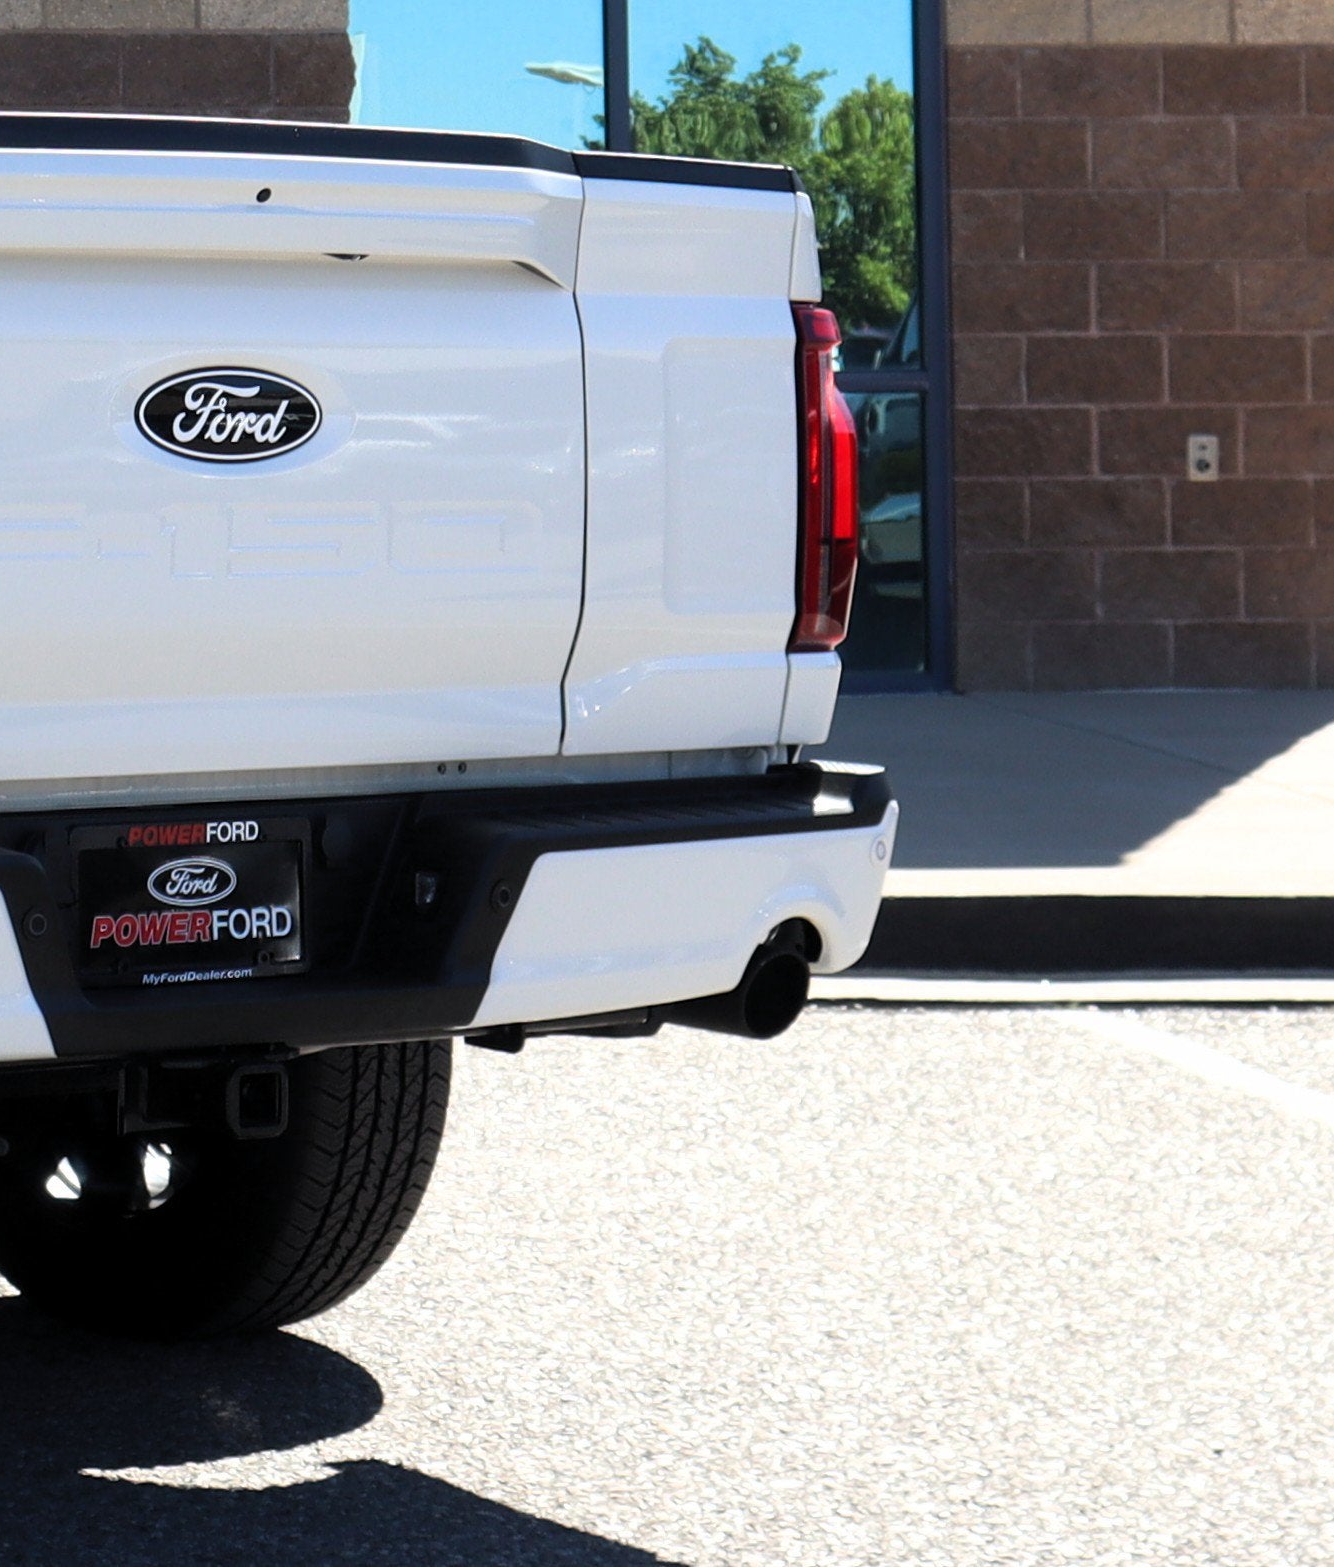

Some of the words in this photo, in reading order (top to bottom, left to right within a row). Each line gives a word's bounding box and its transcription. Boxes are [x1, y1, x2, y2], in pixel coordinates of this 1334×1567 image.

[172, 382, 290, 444] Ford
[128, 820, 259, 846] POWERFORD
[165, 867, 219, 896] Ford
[90, 906, 293, 948] POWERFORD
[142, 968, 253, 985] MyFordDealer.com
